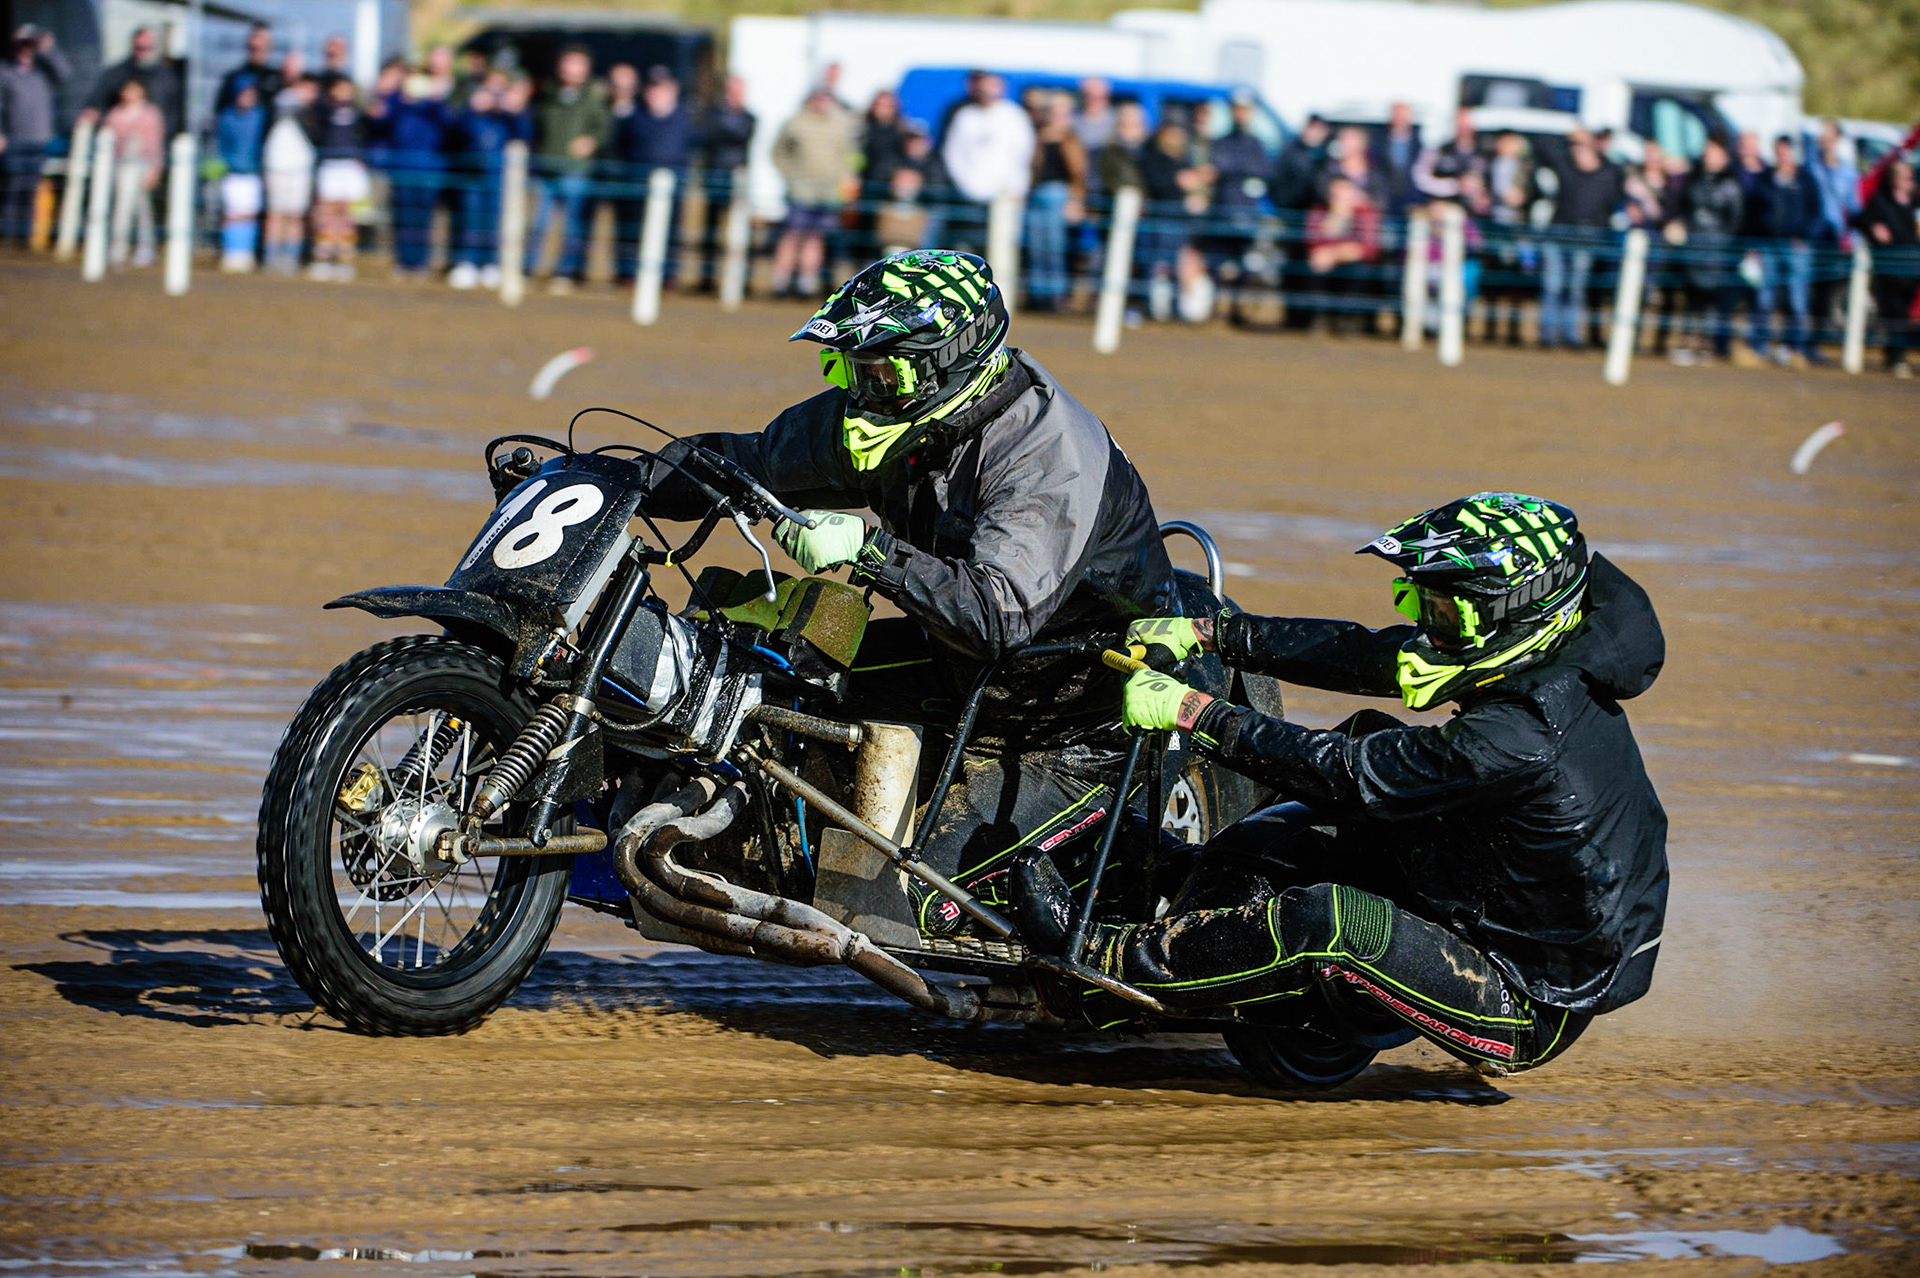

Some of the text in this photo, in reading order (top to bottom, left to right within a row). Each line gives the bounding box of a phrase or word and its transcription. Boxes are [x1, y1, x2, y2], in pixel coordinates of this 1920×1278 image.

[920, 308, 996, 378] 100%
[461, 479, 604, 570] 18
[1488, 558, 1576, 621] 100%
[1414, 1012, 1450, 1034] CAR
[1447, 1028, 1515, 1058] CENTRE
